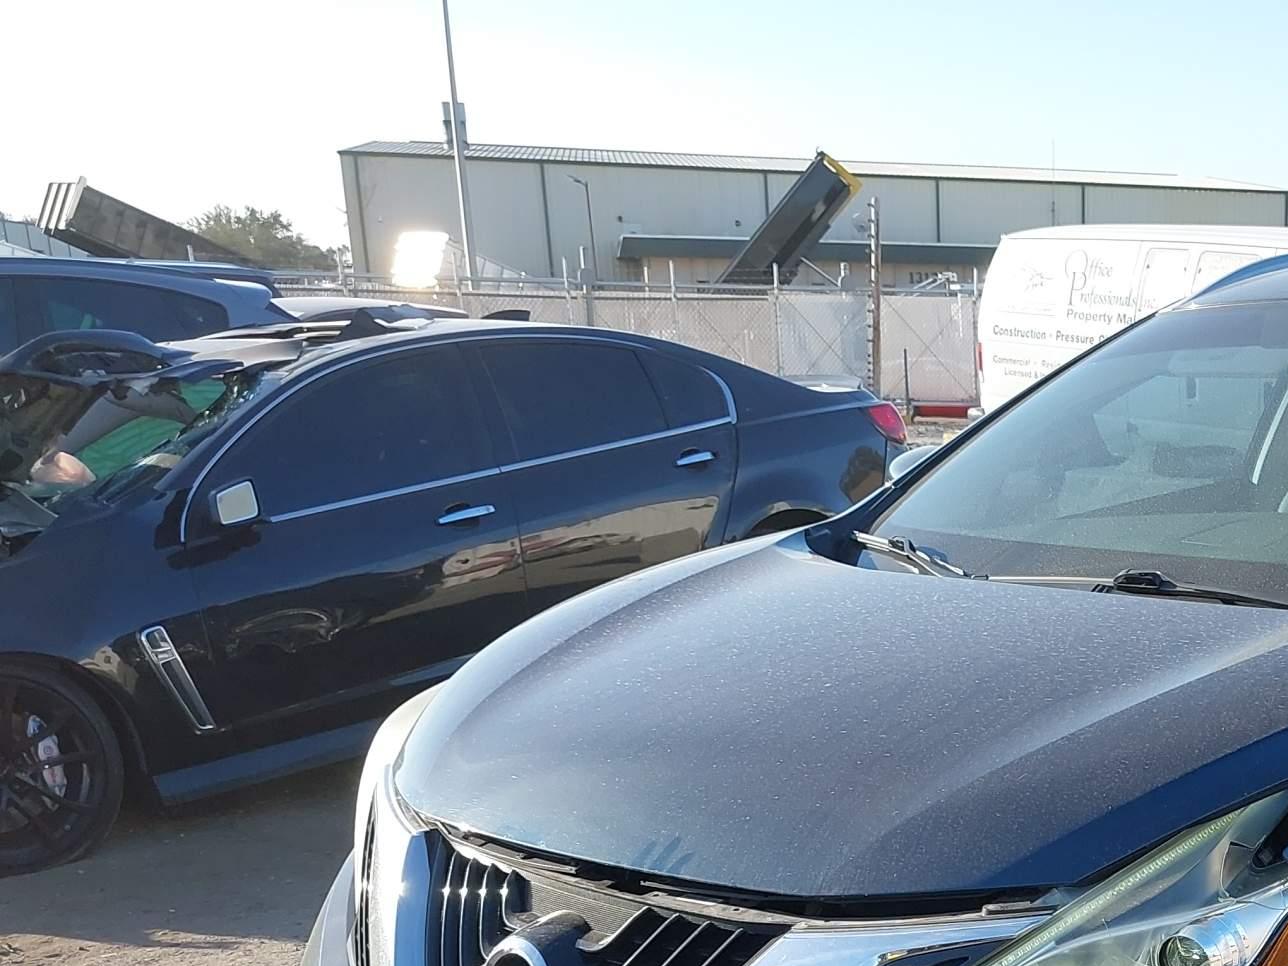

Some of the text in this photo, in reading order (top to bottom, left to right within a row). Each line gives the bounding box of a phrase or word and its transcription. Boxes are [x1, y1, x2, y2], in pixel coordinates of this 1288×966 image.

[1064, 248, 1112, 279] Office
[1067, 272, 1137, 307] Professionals
[1066, 308, 1113, 326] Property
[992, 324, 1047, 340] Construction
[1055, 330, 1095, 345] Pressure
[992, 354, 1031, 366] Commercial
